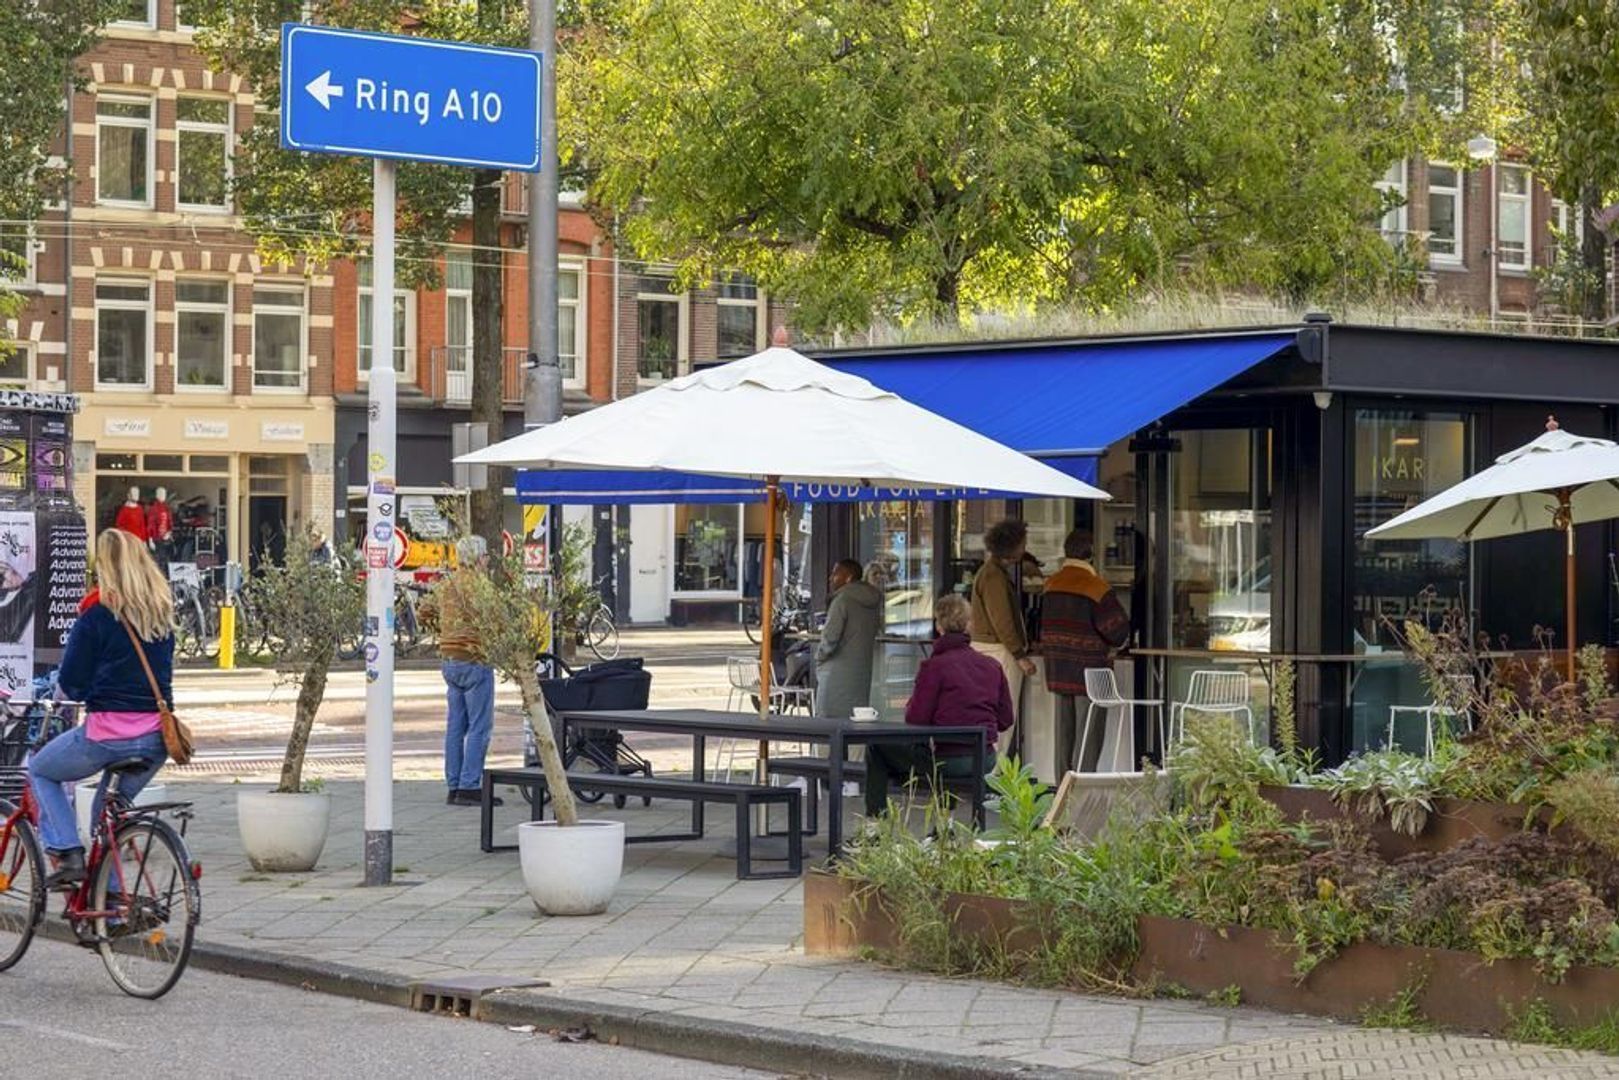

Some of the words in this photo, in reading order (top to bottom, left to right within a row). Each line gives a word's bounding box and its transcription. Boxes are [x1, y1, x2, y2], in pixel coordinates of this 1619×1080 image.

[355, 77, 430, 126] Ring
[442, 88, 502, 123] A10
[793, 482, 860, 498] FOOD
